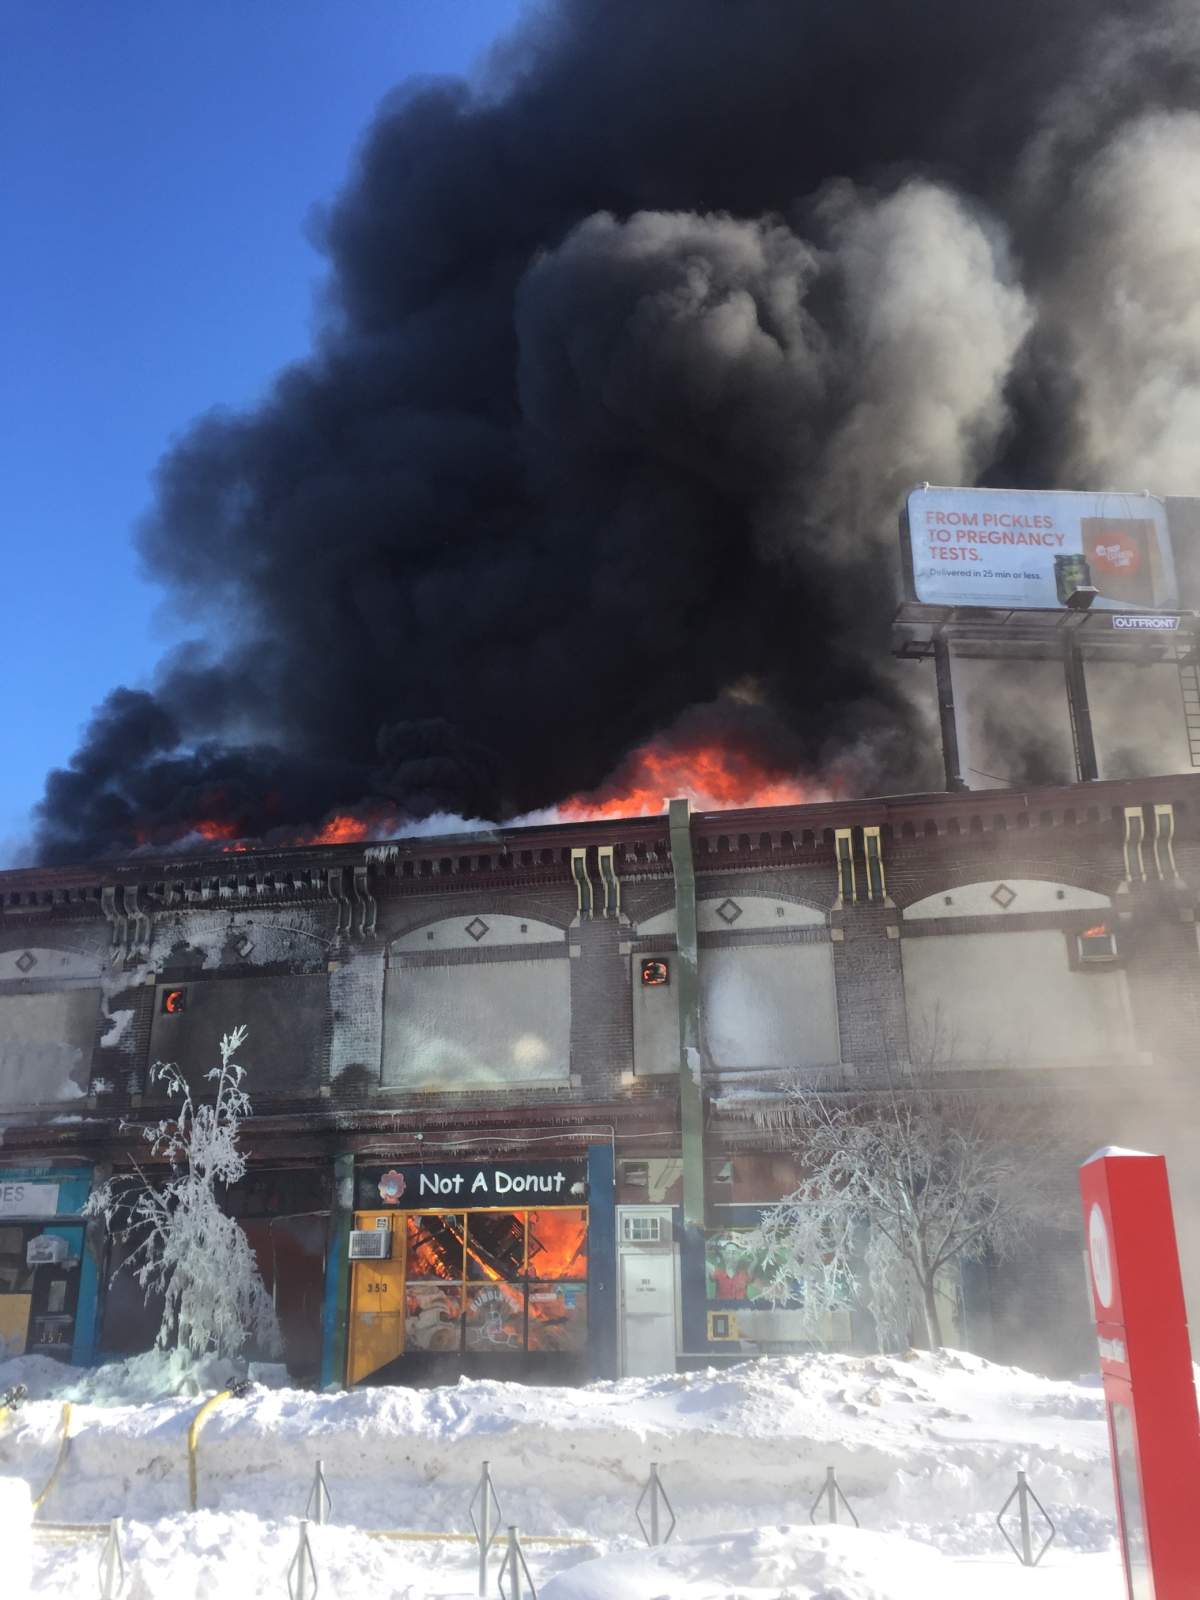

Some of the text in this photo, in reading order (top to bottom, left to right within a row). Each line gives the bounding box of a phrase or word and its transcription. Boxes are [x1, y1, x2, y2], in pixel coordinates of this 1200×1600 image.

[926, 511, 1053, 529] FROM PICKLES
[928, 528, 1065, 546] TO PREGNANCY
[929, 546, 983, 561] TESTS.
[929, 568, 971, 578] Delivered
[973, 569, 981, 578] in
[983, 570, 993, 579] 25
[995, 570, 1011, 579] min
[1023, 571, 1042, 581] less.
[1115, 618, 1175, 628] OUTFRONT
[419, 1171, 566, 1196] Not A Donut
[367, 1283, 388, 1293] 353
